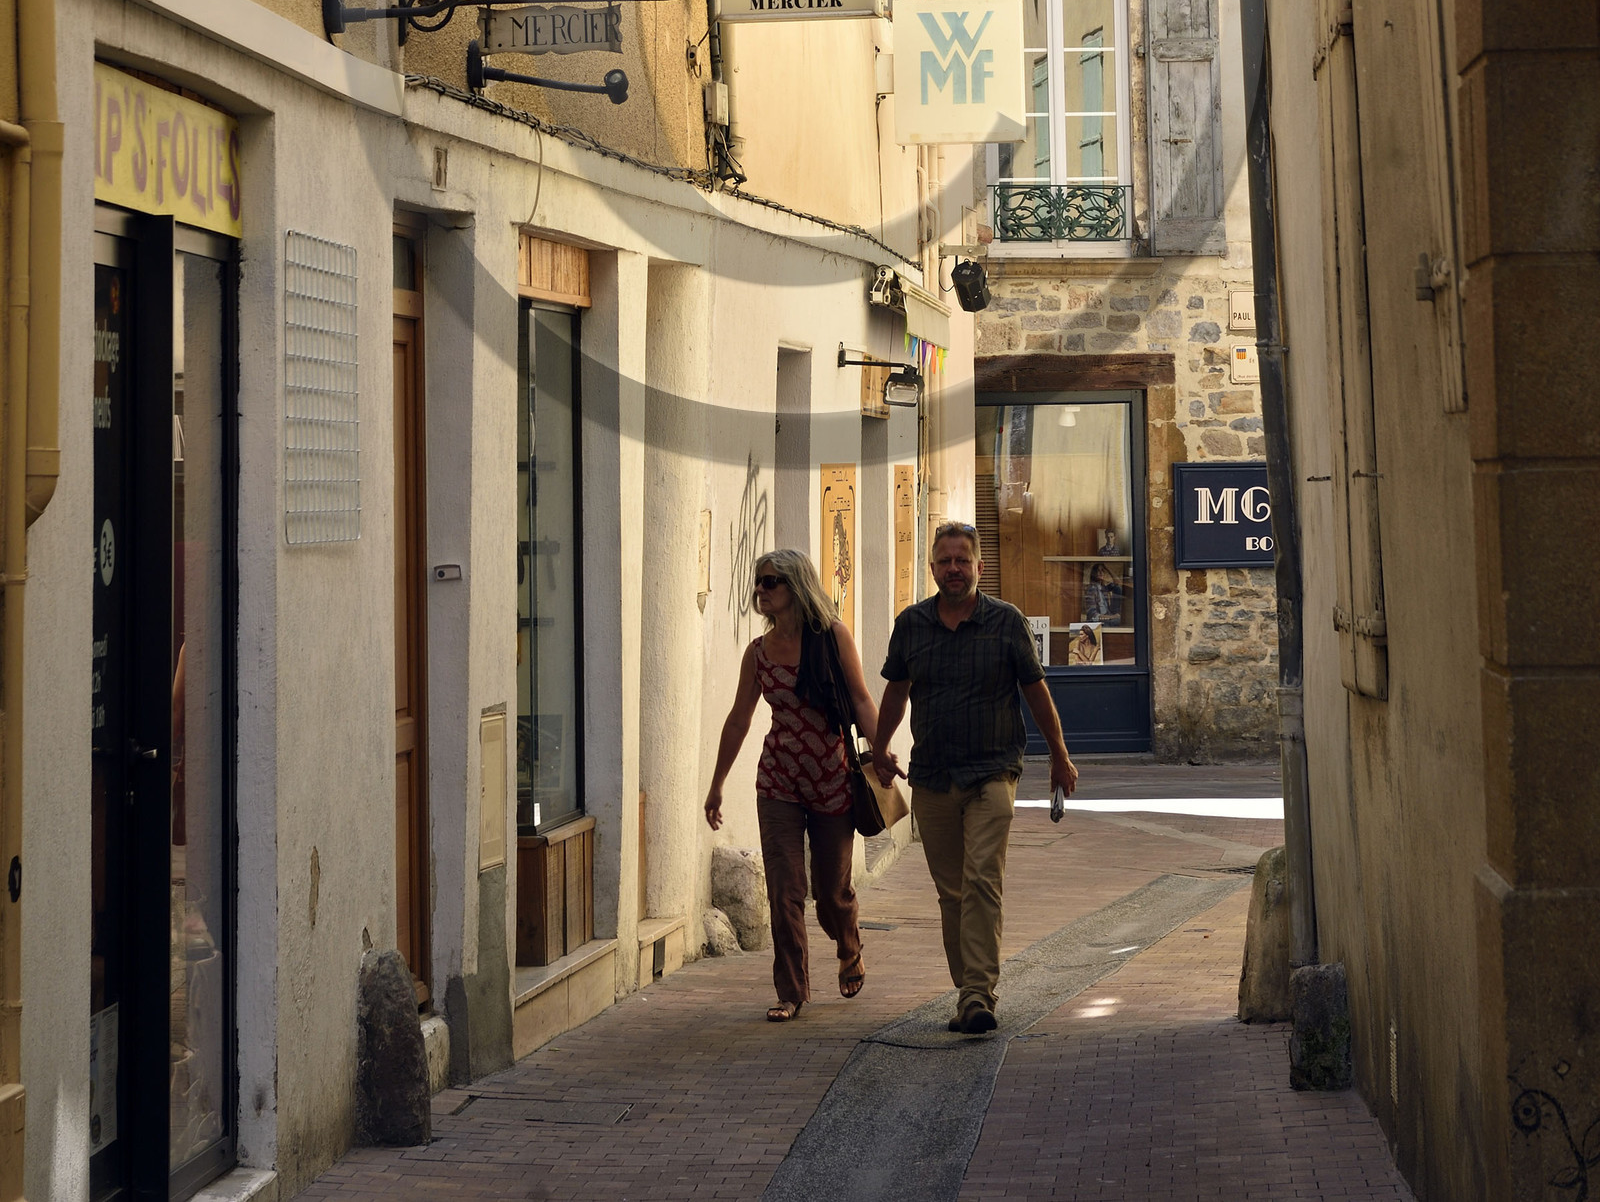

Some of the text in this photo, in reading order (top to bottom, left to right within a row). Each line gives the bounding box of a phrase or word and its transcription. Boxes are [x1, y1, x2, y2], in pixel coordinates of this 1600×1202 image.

[156, 111, 241, 221] FOLIES
[1233, 312, 1251, 320] PAUL
[1245, 536, 1274, 552] BO
